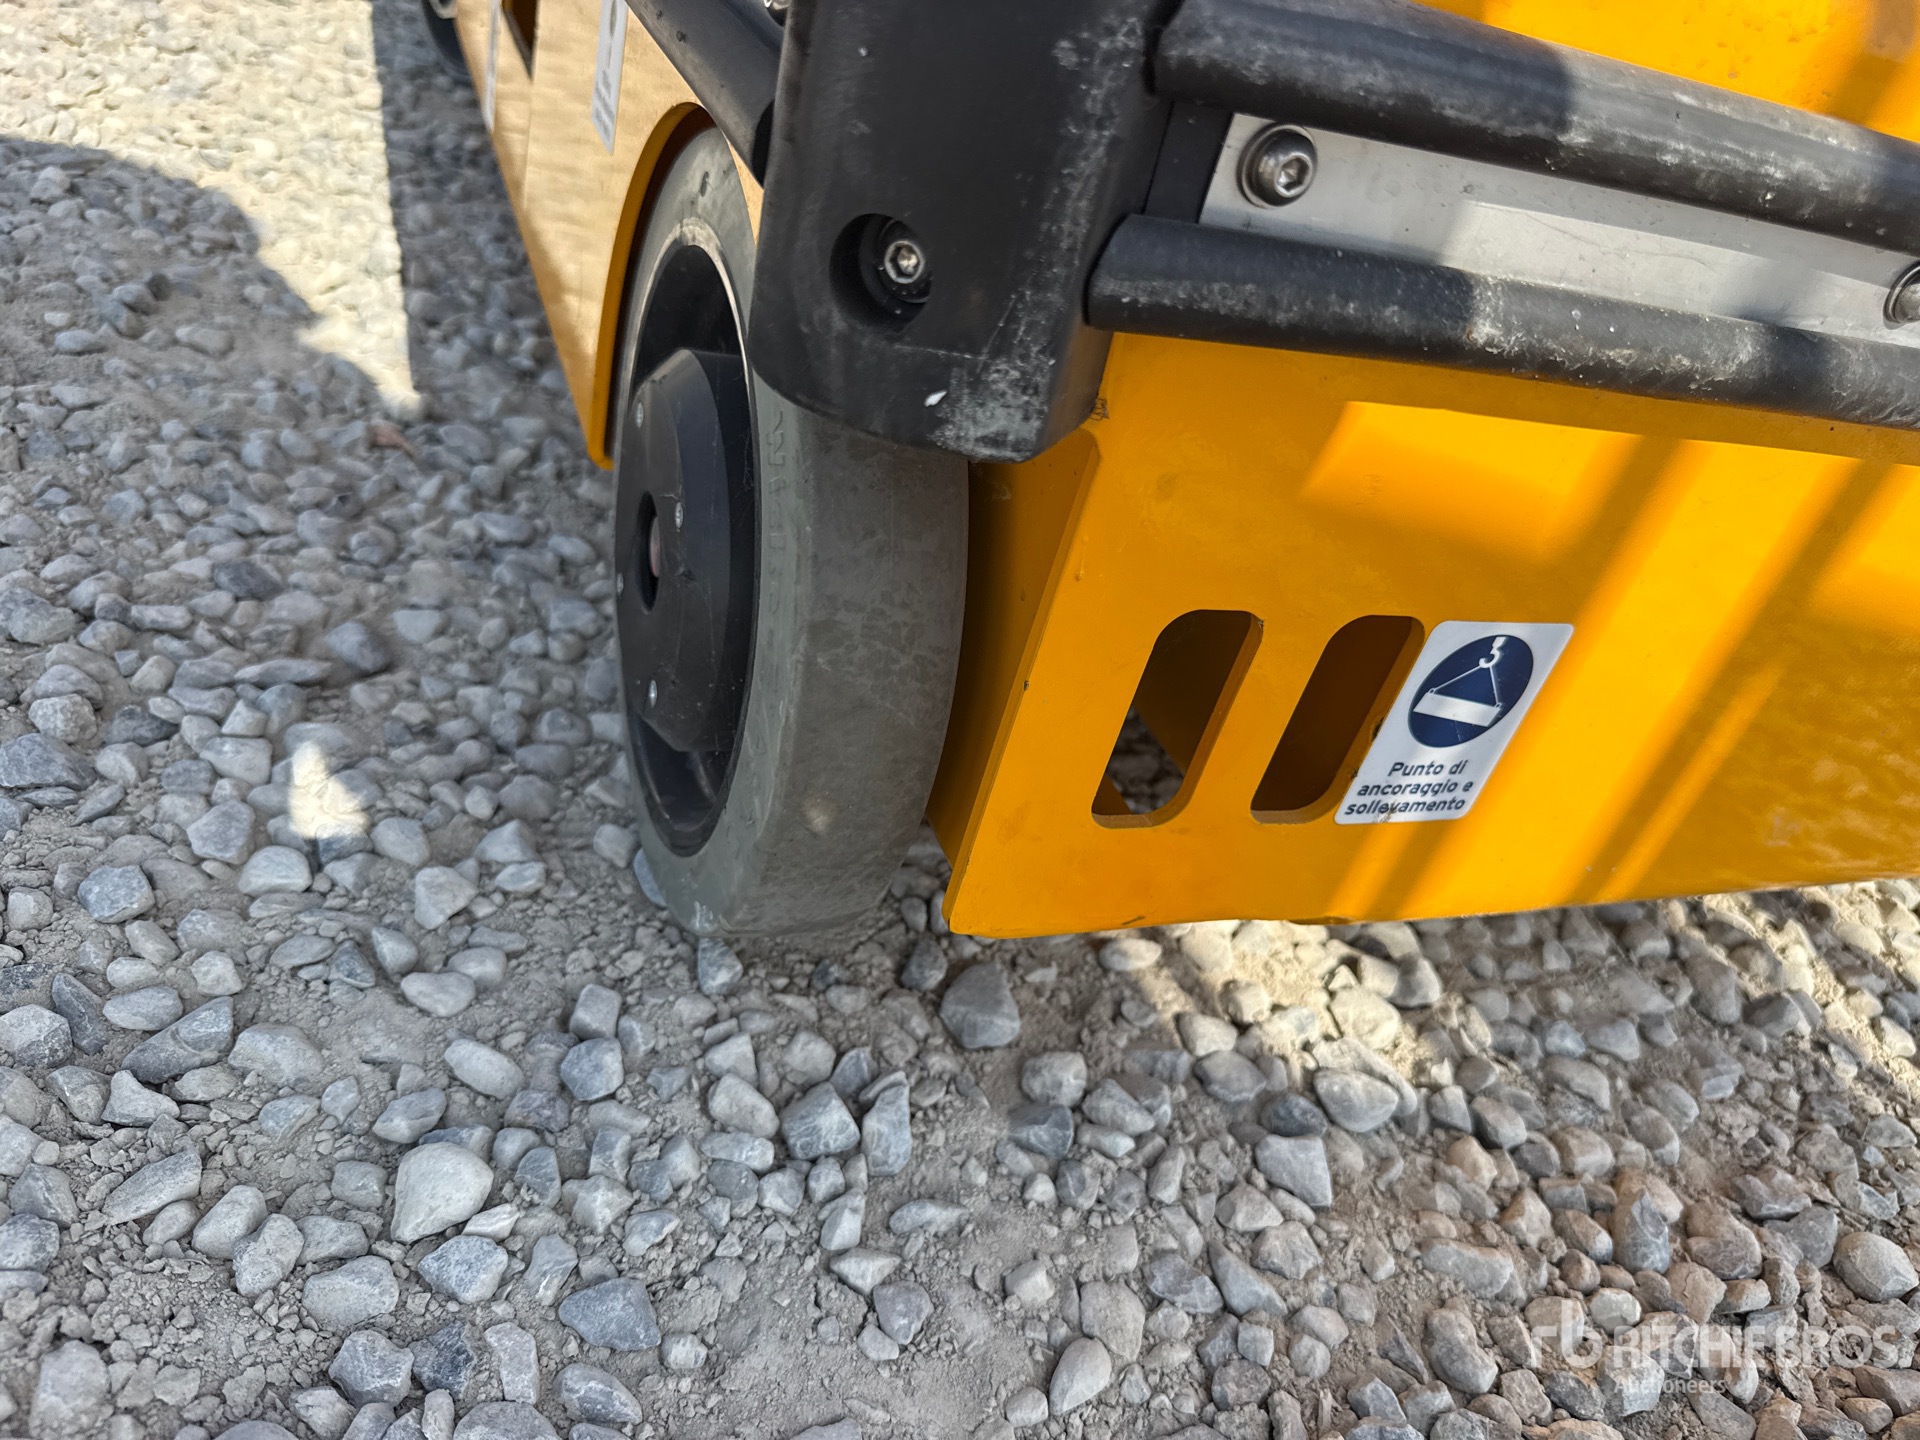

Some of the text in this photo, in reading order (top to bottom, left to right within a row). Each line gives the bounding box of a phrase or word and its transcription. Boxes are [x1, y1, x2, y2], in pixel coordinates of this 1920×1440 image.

[1387, 759, 1468, 776] Punto di
[1357, 779, 1474, 797] ancoraggio e
[1344, 797, 1466, 815] sollevamento
